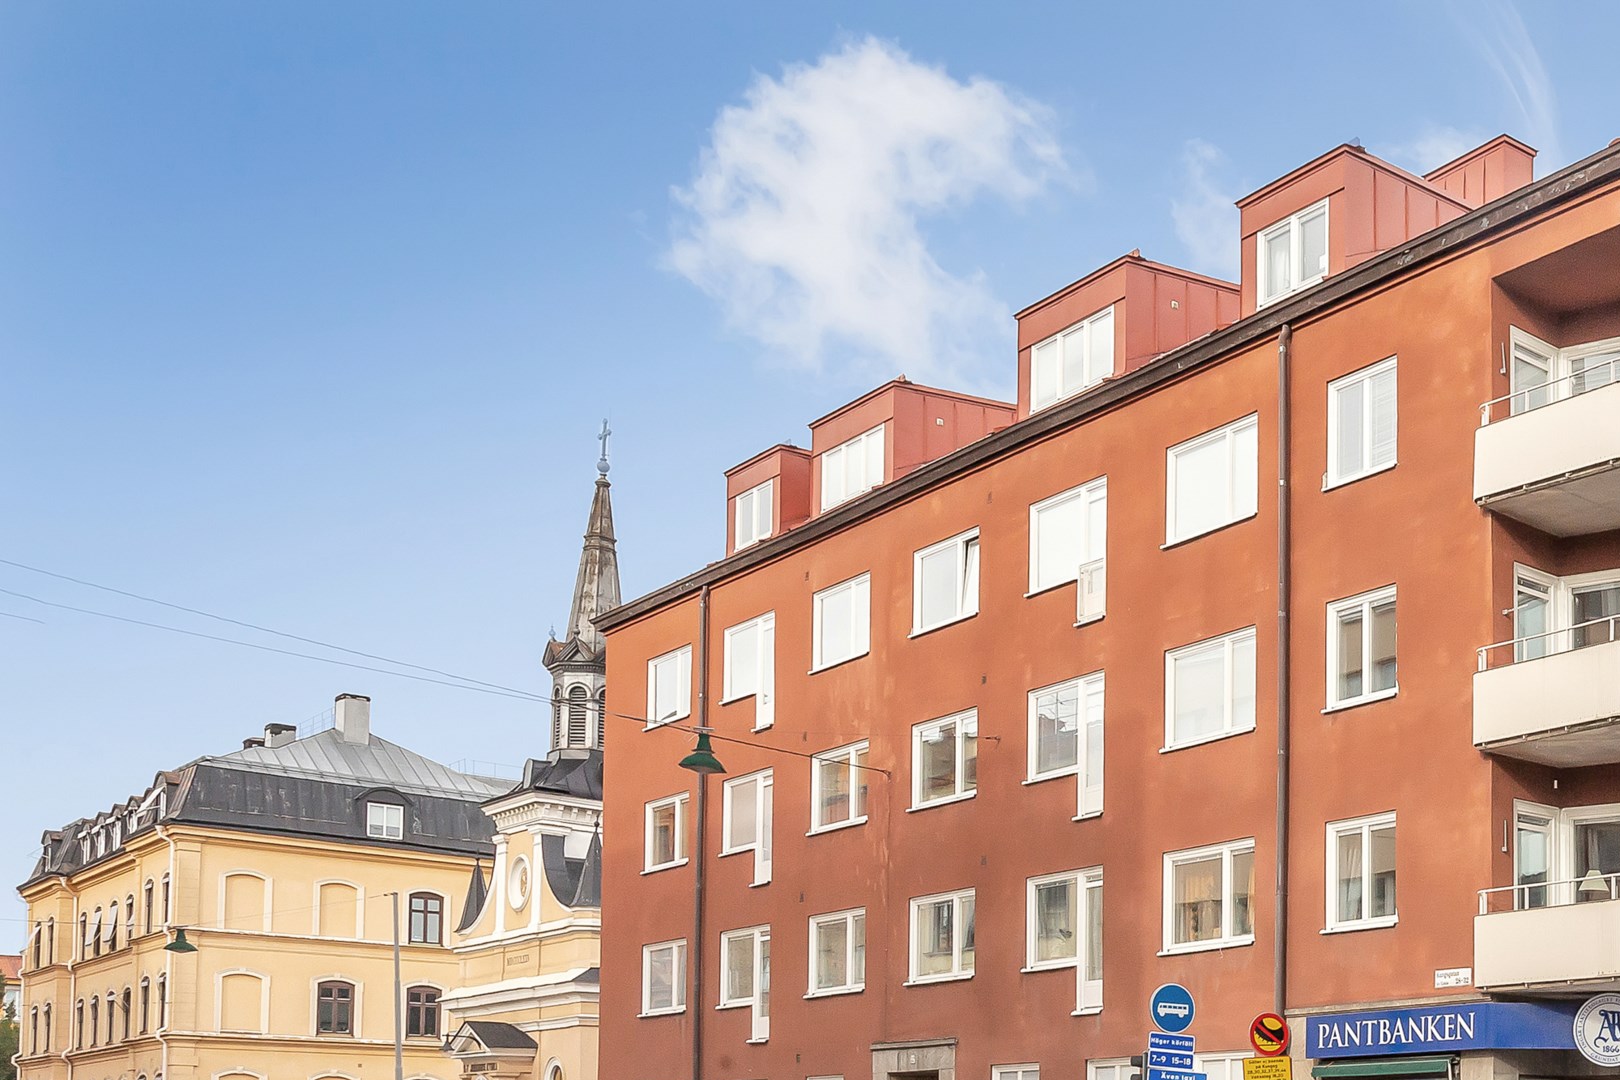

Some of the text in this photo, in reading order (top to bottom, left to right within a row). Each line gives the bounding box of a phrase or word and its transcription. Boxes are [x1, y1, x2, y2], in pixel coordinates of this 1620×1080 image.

[1318, 1012, 1475, 1049] PANTBANKEN
[1151, 1055, 1191, 1065] 7-9 15-18
[1161, 1071, 1180, 1080] Även
